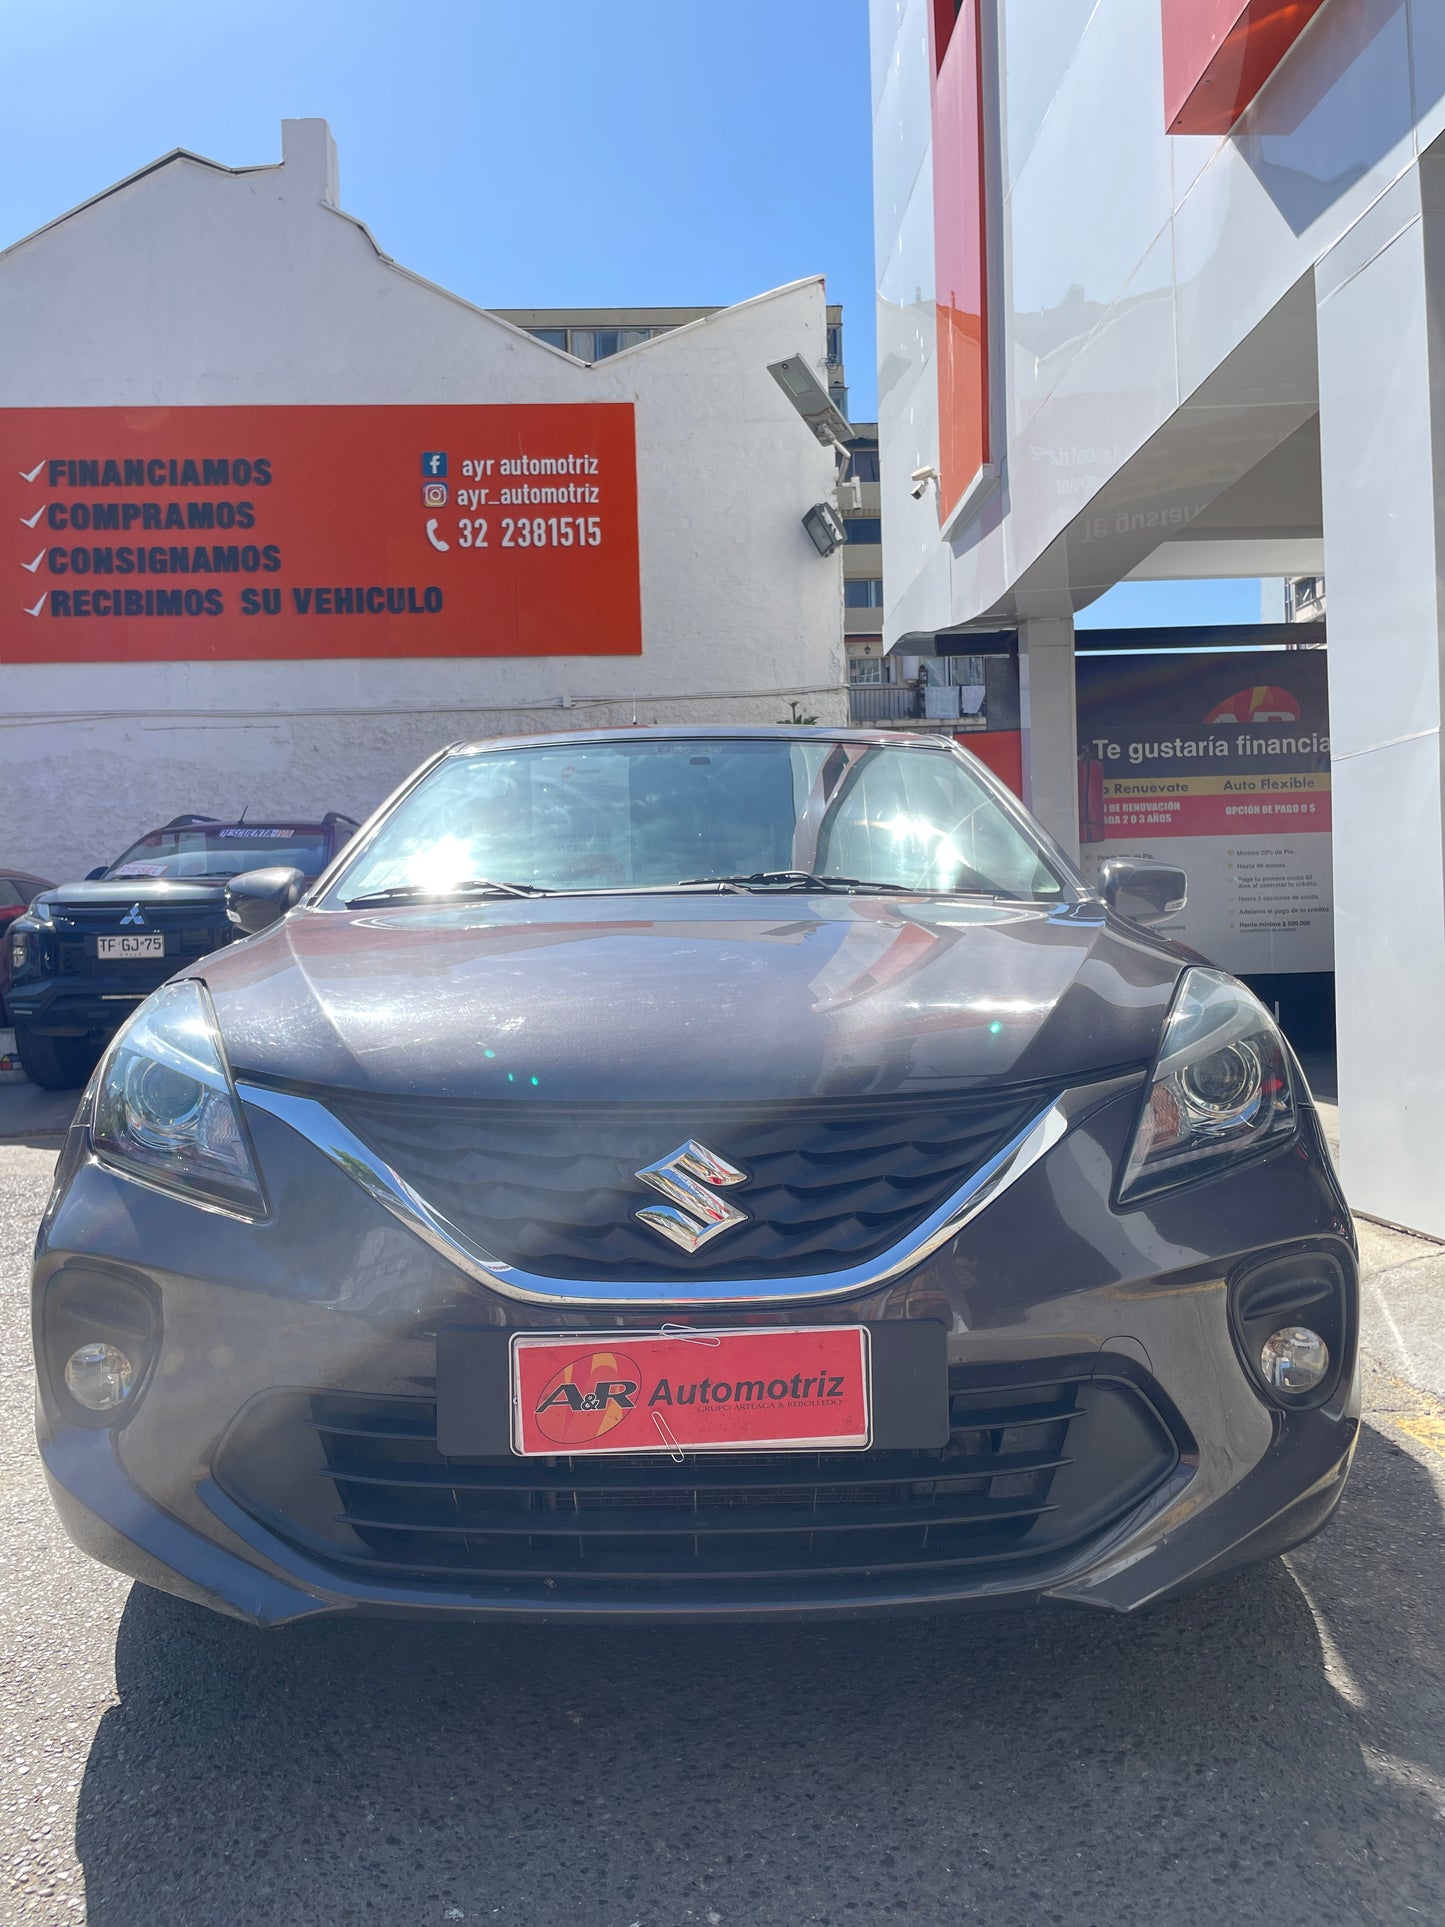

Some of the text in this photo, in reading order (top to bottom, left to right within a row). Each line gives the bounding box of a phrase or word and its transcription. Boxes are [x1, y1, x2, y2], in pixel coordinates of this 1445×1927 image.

[48, 459, 272, 487] FINANCIAMOS
[462, 454, 599, 481] ayr automotriz
[457, 483, 600, 511] ayr_automotriz
[47, 502, 256, 531] COMPRAMOS
[458, 517, 602, 548] 32 2381515
[47, 544, 282, 574] CONSIGNAMOS
[50, 586, 444, 618] RECIBIMOS SU VEHICULO
[1092, 739, 1121, 760] Te
[1128, 735, 1228, 764] gustaría
[1223, 777, 1315, 791] Auto Flexible
[1109, 803, 1120, 813] DE
[1122, 801, 1181, 812] RENOVACIÓN
[1122, 815, 1129, 824] 2
[1138, 814, 1145, 824] 3
[1147, 812, 1172, 823] AÑOS
[1225, 804, 1260, 815] OPCIÓN
[1262, 805, 1273, 814] DE
[1274, 804, 1299, 813] PAGO
[1309, 803, 1316, 813] $
[144, 937, 161, 951] 75
[534, 1379, 638, 1414] A&R
[647, 1370, 845, 1406] Automotriz
[697, 1399, 842, 1413] GRUPO ARTEAGA & REBOLLEDO
